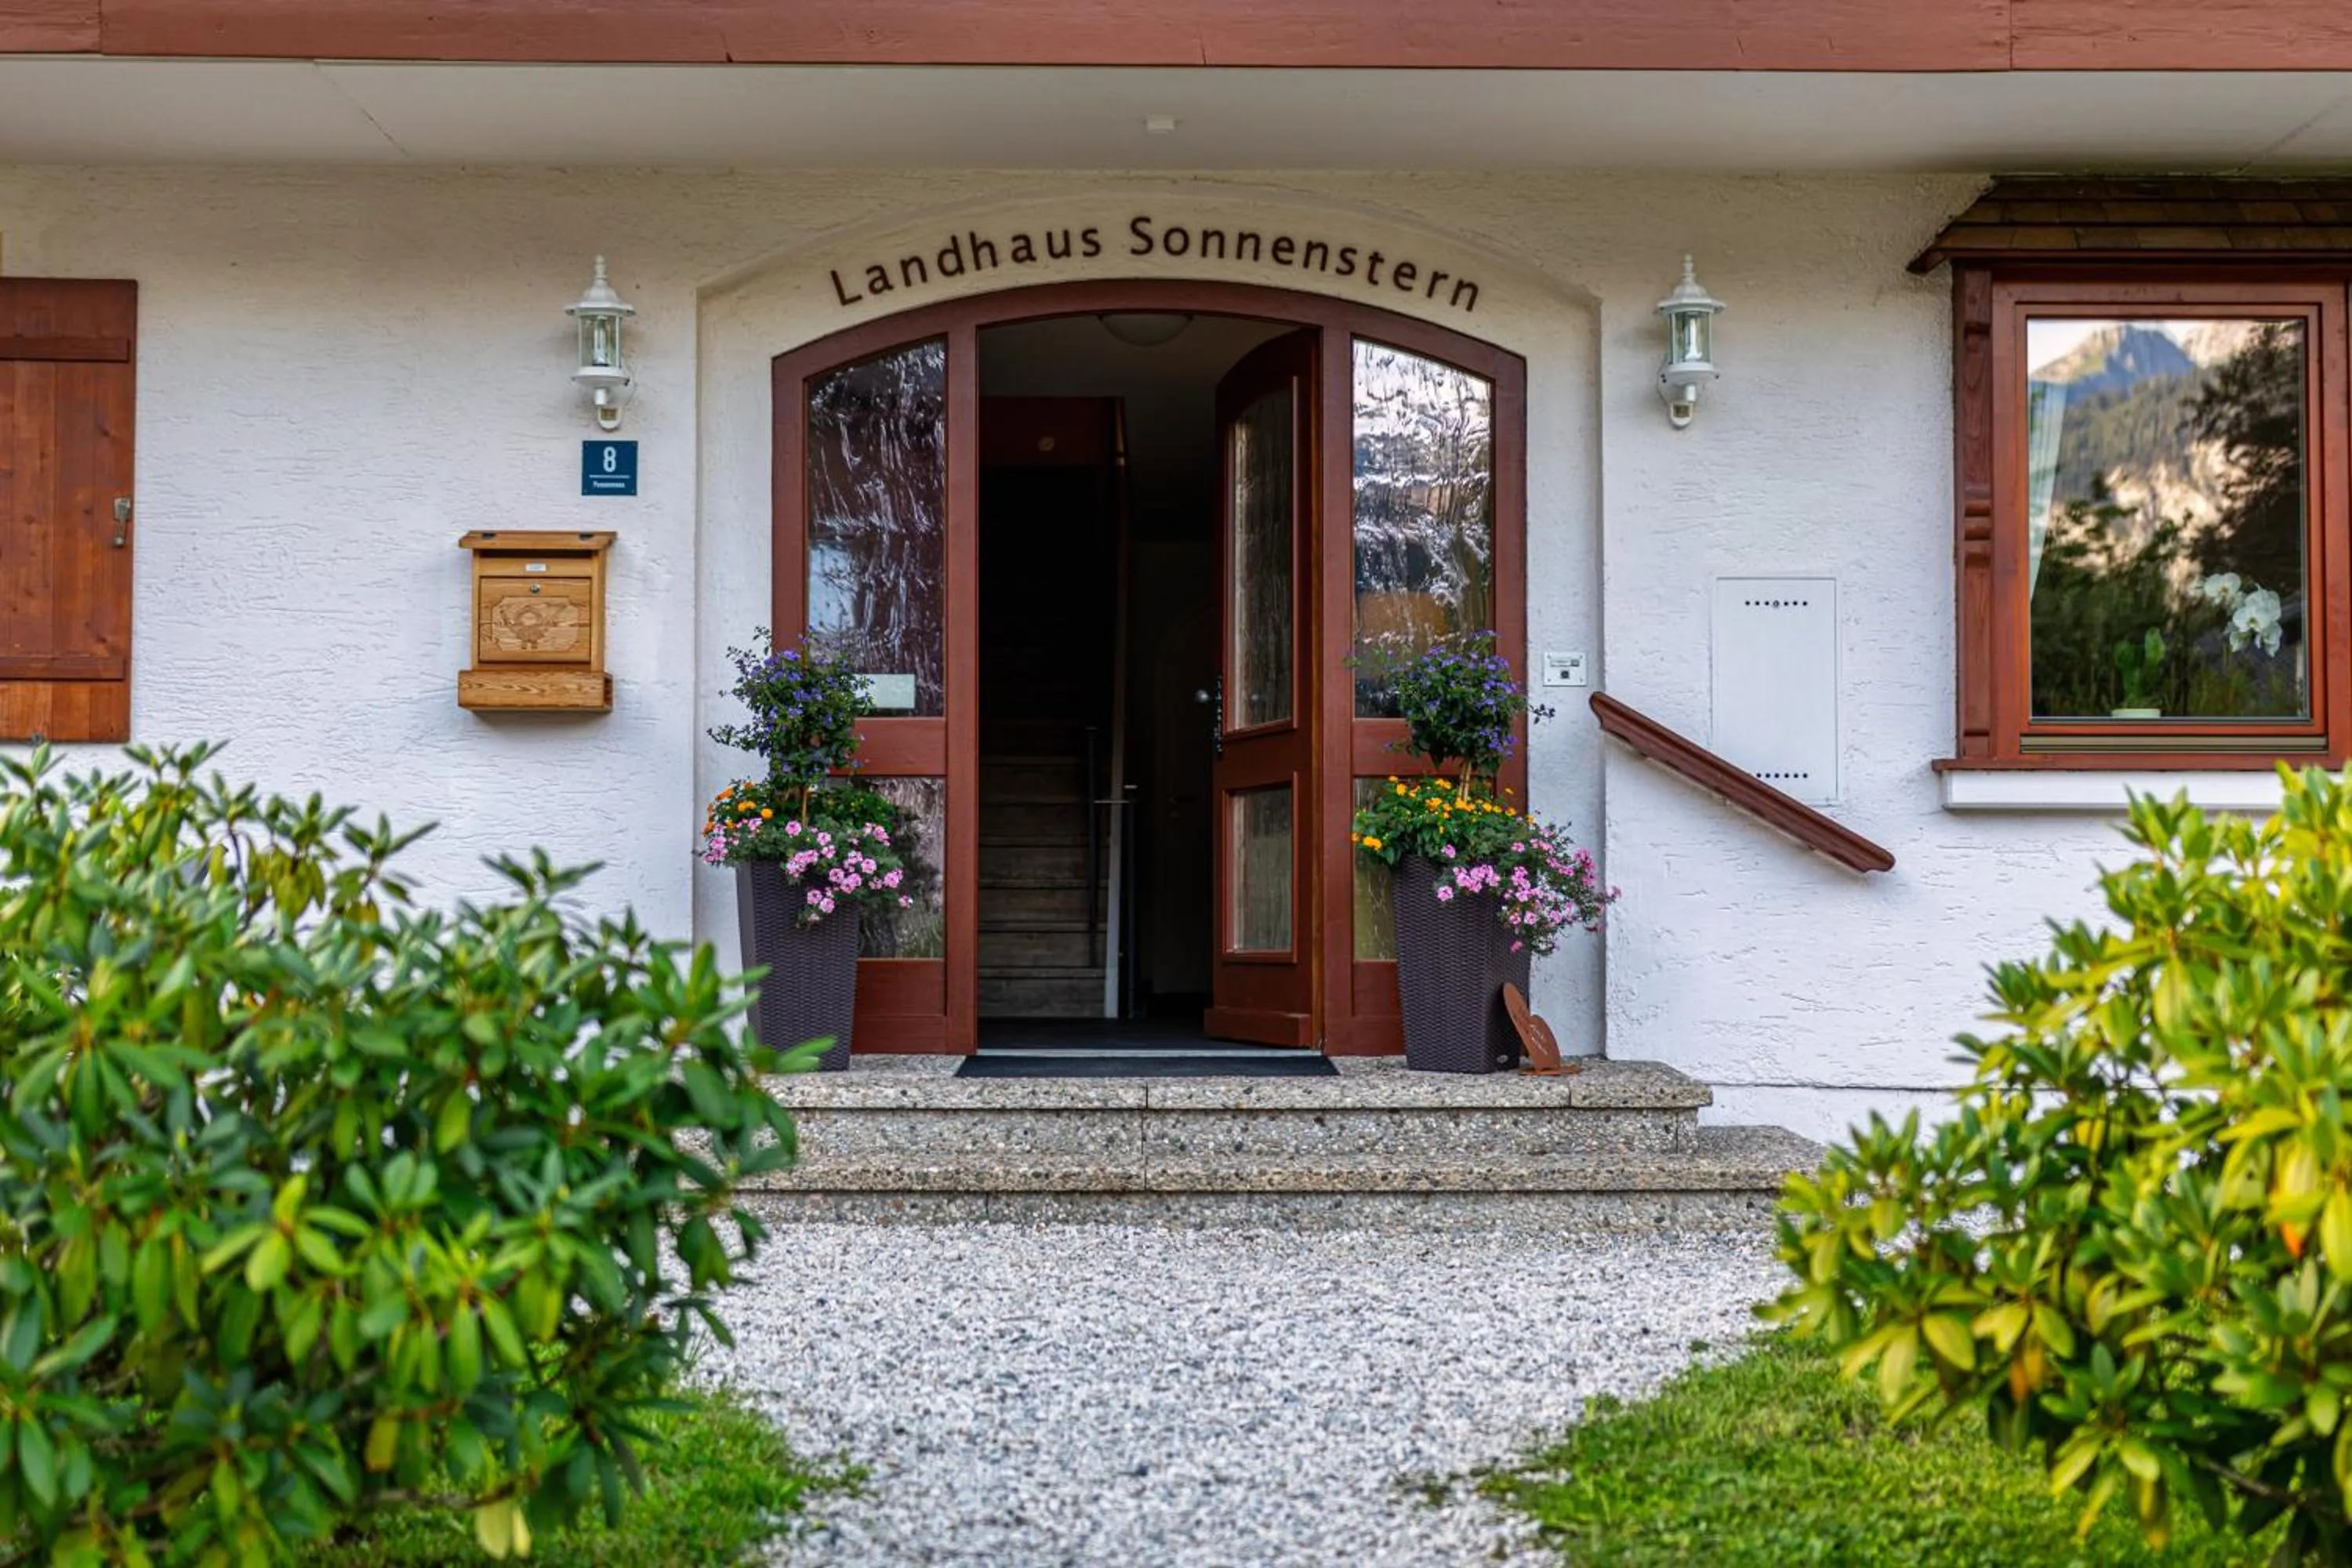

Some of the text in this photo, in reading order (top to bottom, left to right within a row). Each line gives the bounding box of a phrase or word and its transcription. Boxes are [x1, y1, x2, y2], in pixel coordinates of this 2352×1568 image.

[829, 216, 1479, 312] Landhaus Sonnenstern
[603, 446, 617, 472] 8
